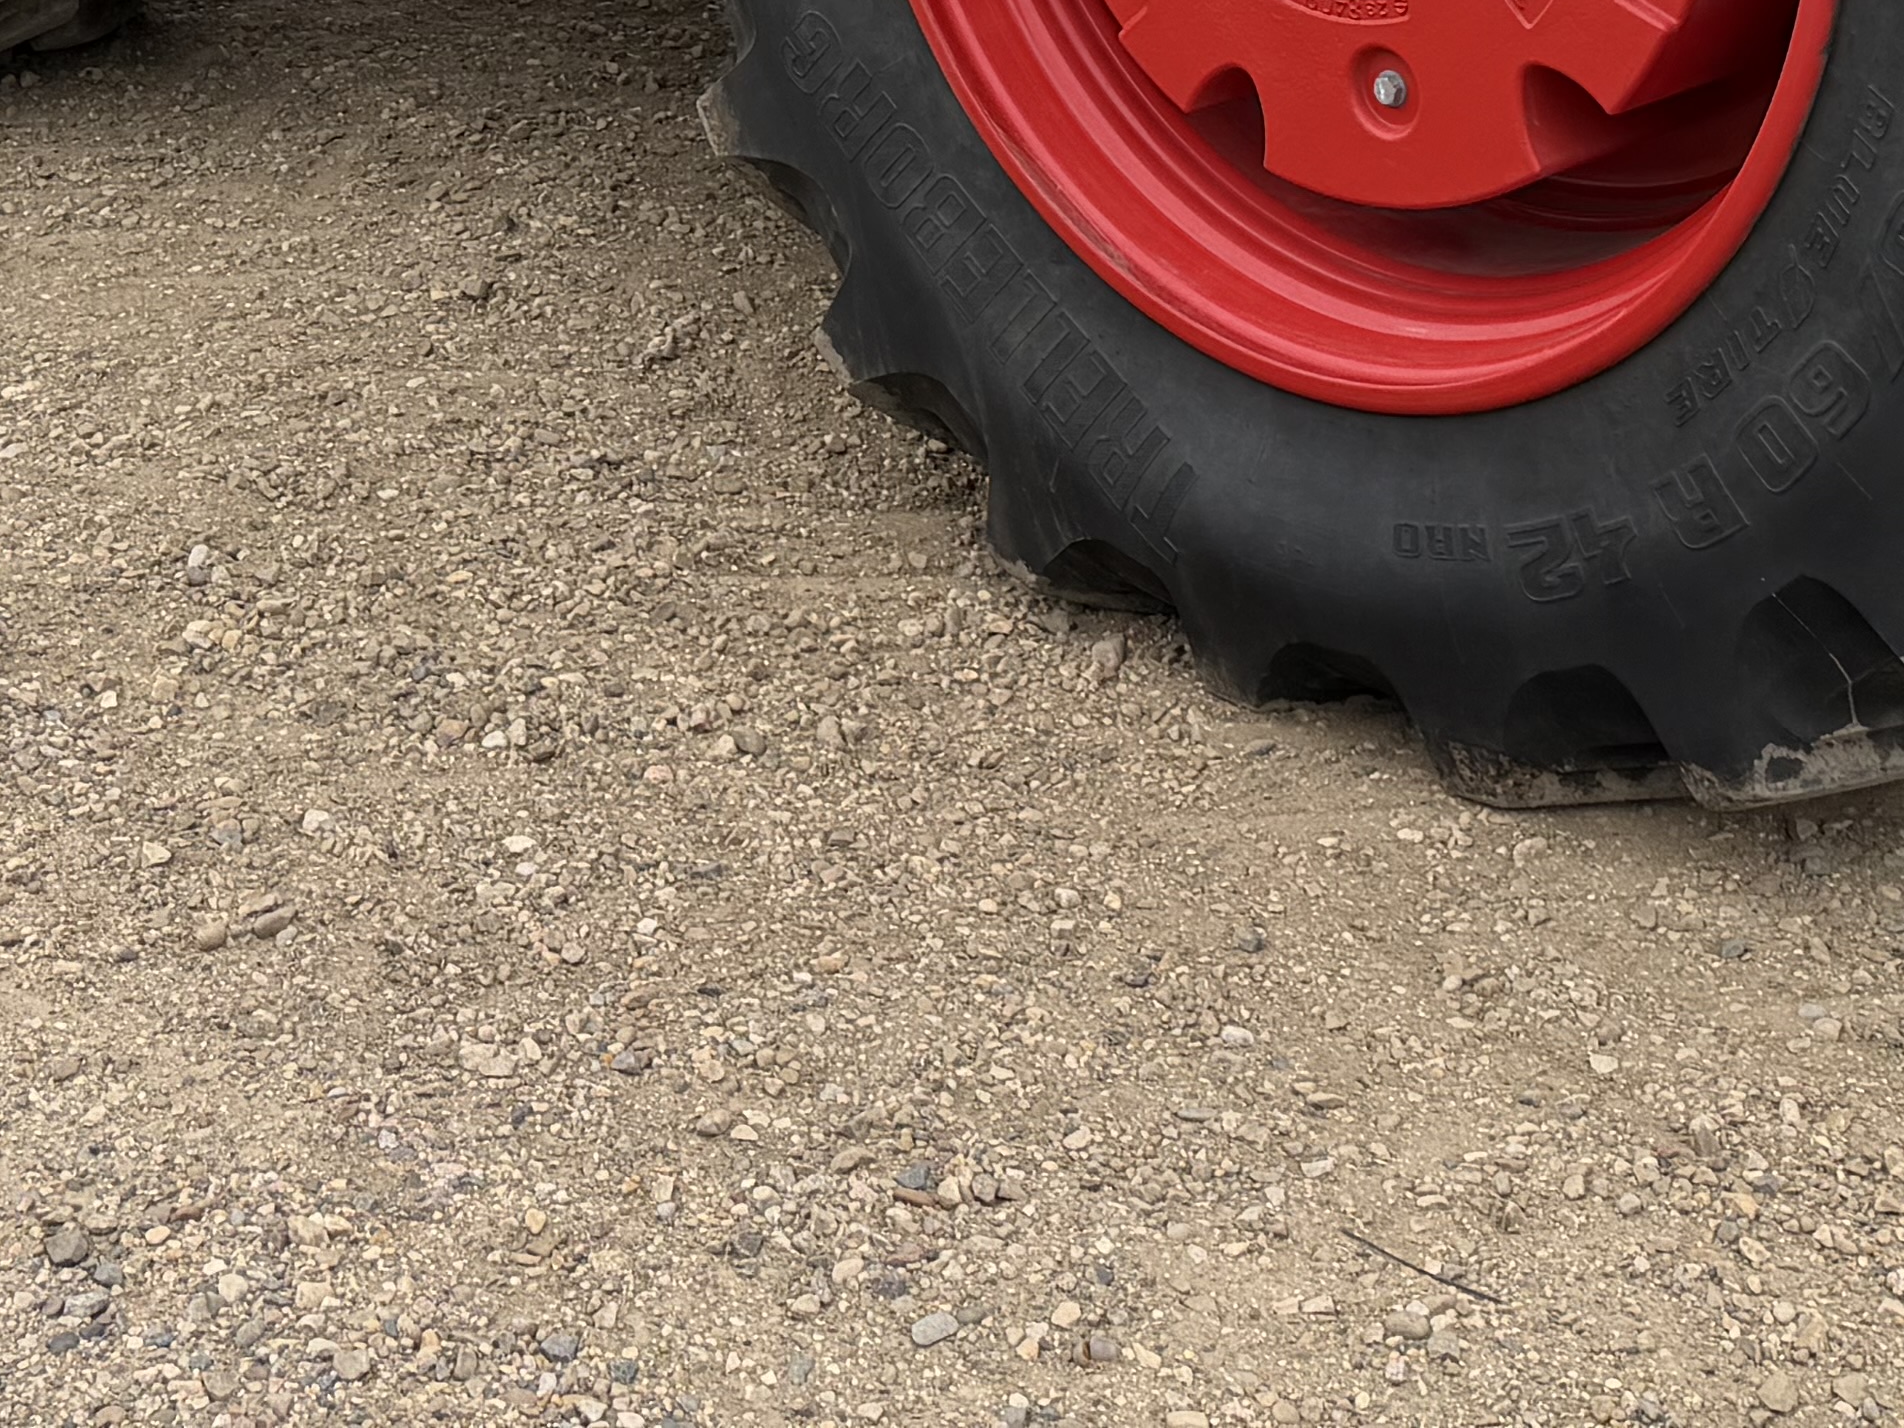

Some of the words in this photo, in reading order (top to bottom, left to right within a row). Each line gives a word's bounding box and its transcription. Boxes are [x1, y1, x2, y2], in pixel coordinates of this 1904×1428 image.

[784, 7, 1193, 564] TRELLEBORG
[1651, 452, 1752, 552] R
[1506, 510, 1637, 604] 42
